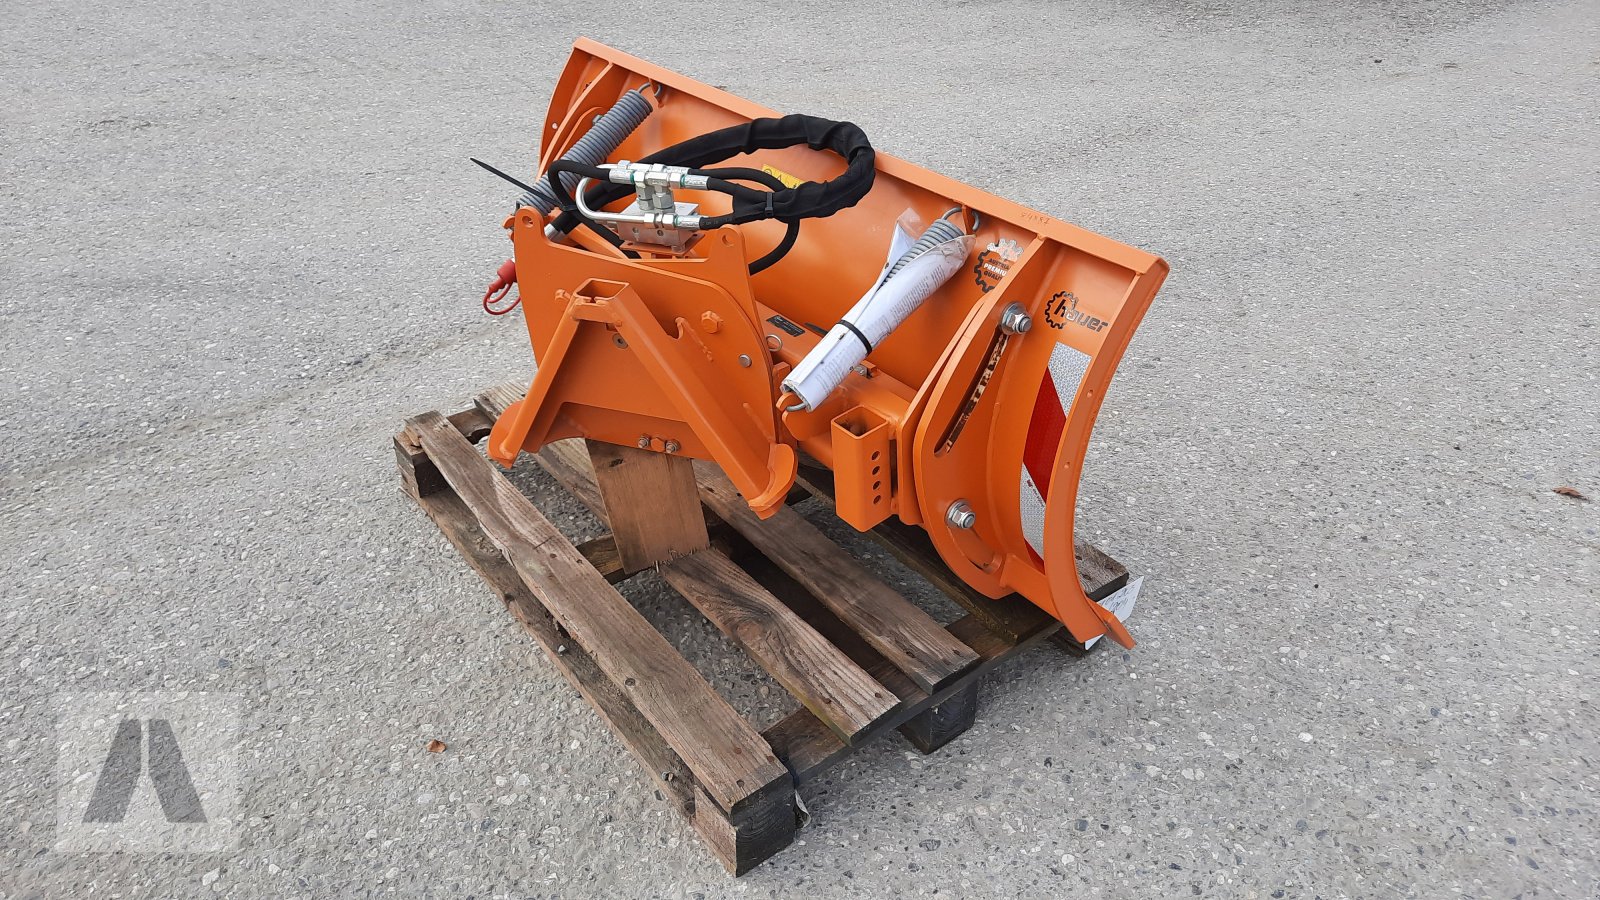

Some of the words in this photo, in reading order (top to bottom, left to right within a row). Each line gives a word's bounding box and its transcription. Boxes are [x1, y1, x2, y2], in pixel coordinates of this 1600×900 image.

[983, 262, 1007, 277] PREMIU
[983, 270, 1003, 281] QUALIT
[1053, 299, 1109, 332] hauer
